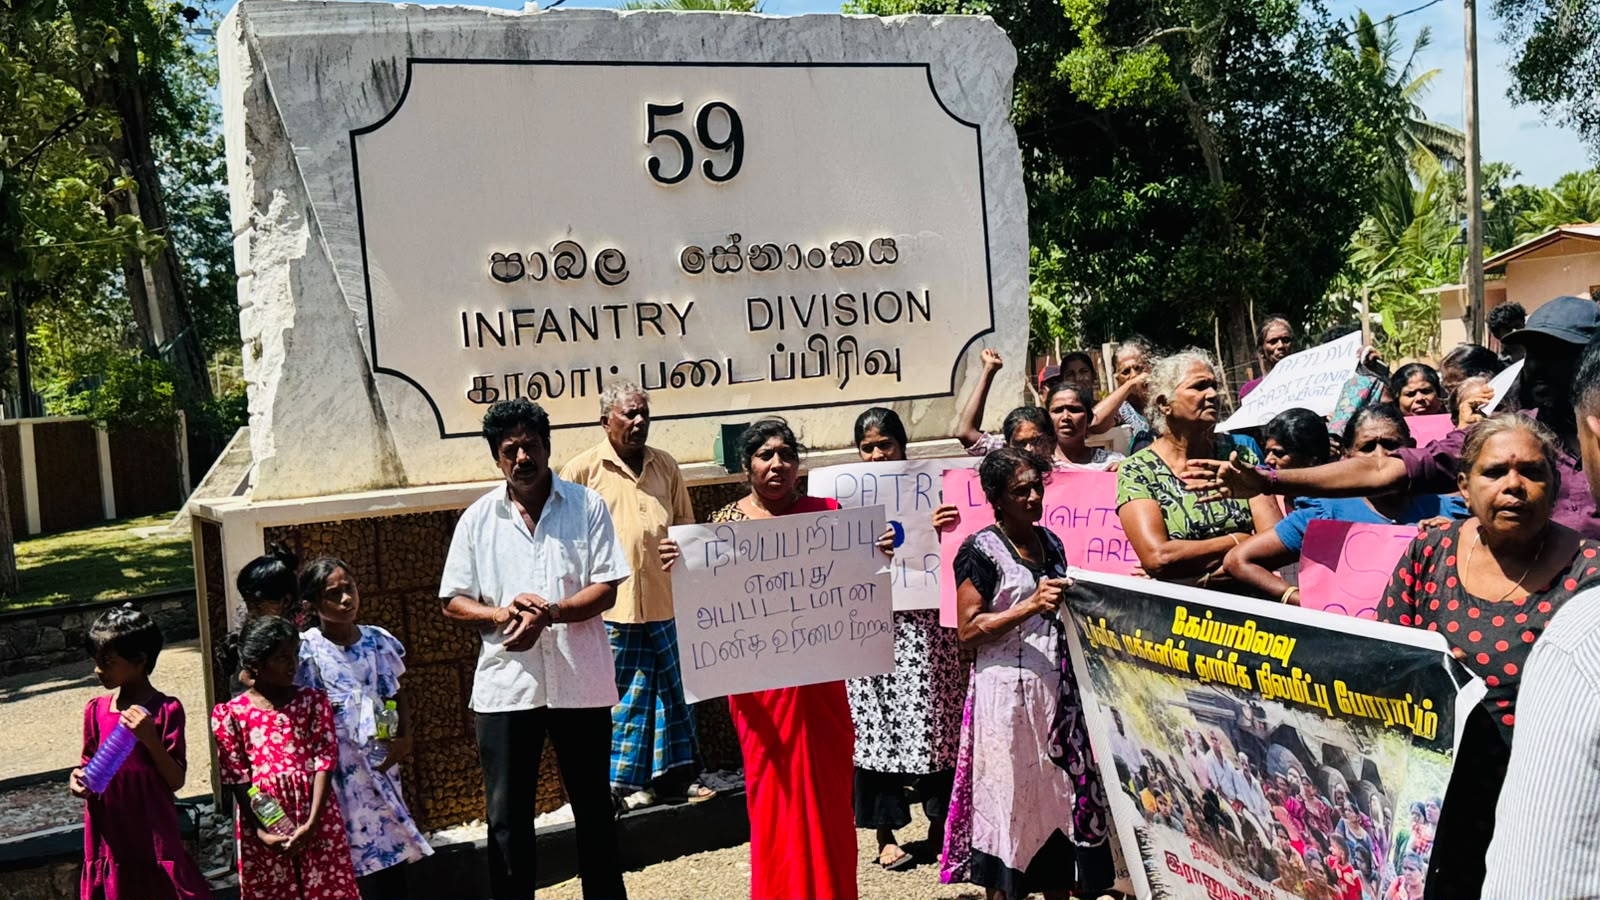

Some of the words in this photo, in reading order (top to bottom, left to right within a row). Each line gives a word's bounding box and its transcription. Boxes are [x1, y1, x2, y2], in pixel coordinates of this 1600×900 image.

[644, 101, 745, 185] 59
[489, 239, 630, 286] පාබල
[679, 233, 899, 275] සේනාංකය
[461, 301, 694, 348] INFANTRY
[746, 290, 931, 332] DIVISION
[835, 472, 944, 512] PATR
[692, 629, 767, 670] மனித
[1171, 605, 1297, 668] கேப்பாபிலவு
[1121, 629, 1191, 673] மக்களின்
[1195, 649, 1252, 690] தார்மீக
[1256, 662, 1334, 717] நிலமீட்பு
